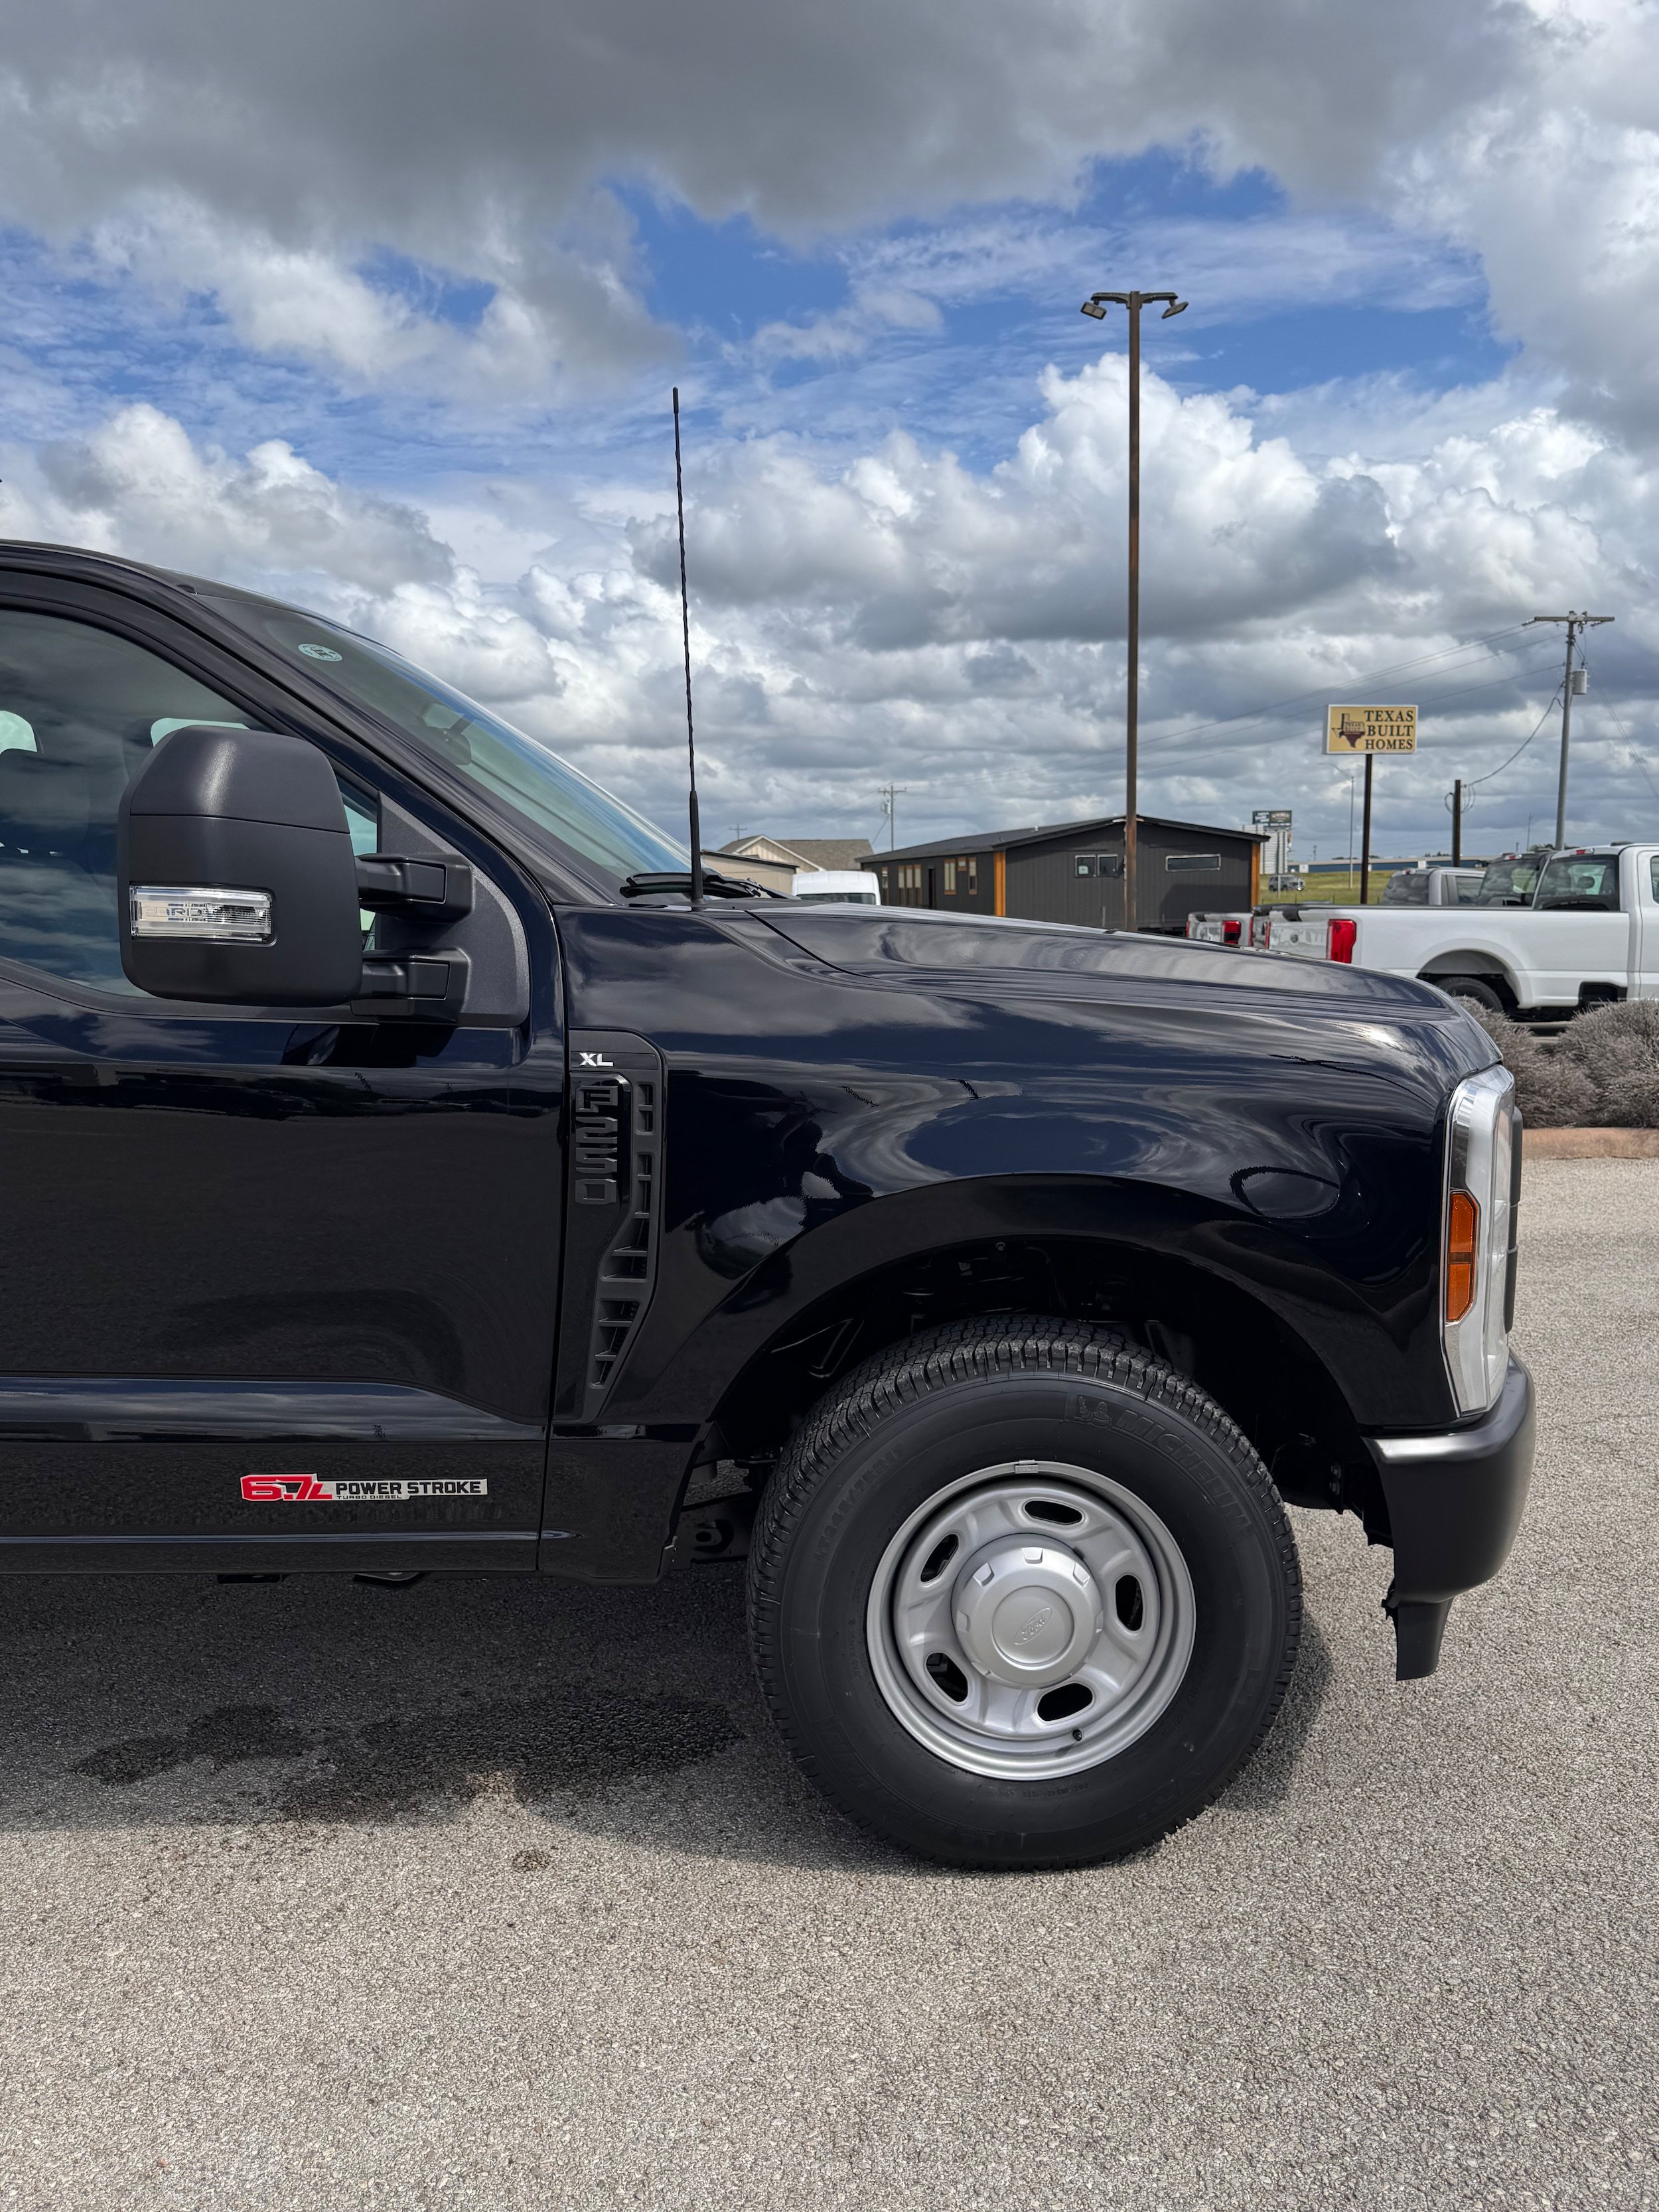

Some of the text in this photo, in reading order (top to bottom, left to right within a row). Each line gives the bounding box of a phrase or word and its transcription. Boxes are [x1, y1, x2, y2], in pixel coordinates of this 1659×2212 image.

[1364, 710, 1414, 722] TEXAS
[1366, 725, 1414, 737] BUILT
[1365, 739, 1413, 750] HOMES
[579, 1052, 614, 1067] XL
[1115, 1408, 1251, 1535] MICHELIN
[240, 1474, 482, 1501] 6.7L POWER STROKE
[1021, 1613, 1047, 1641] Ford
